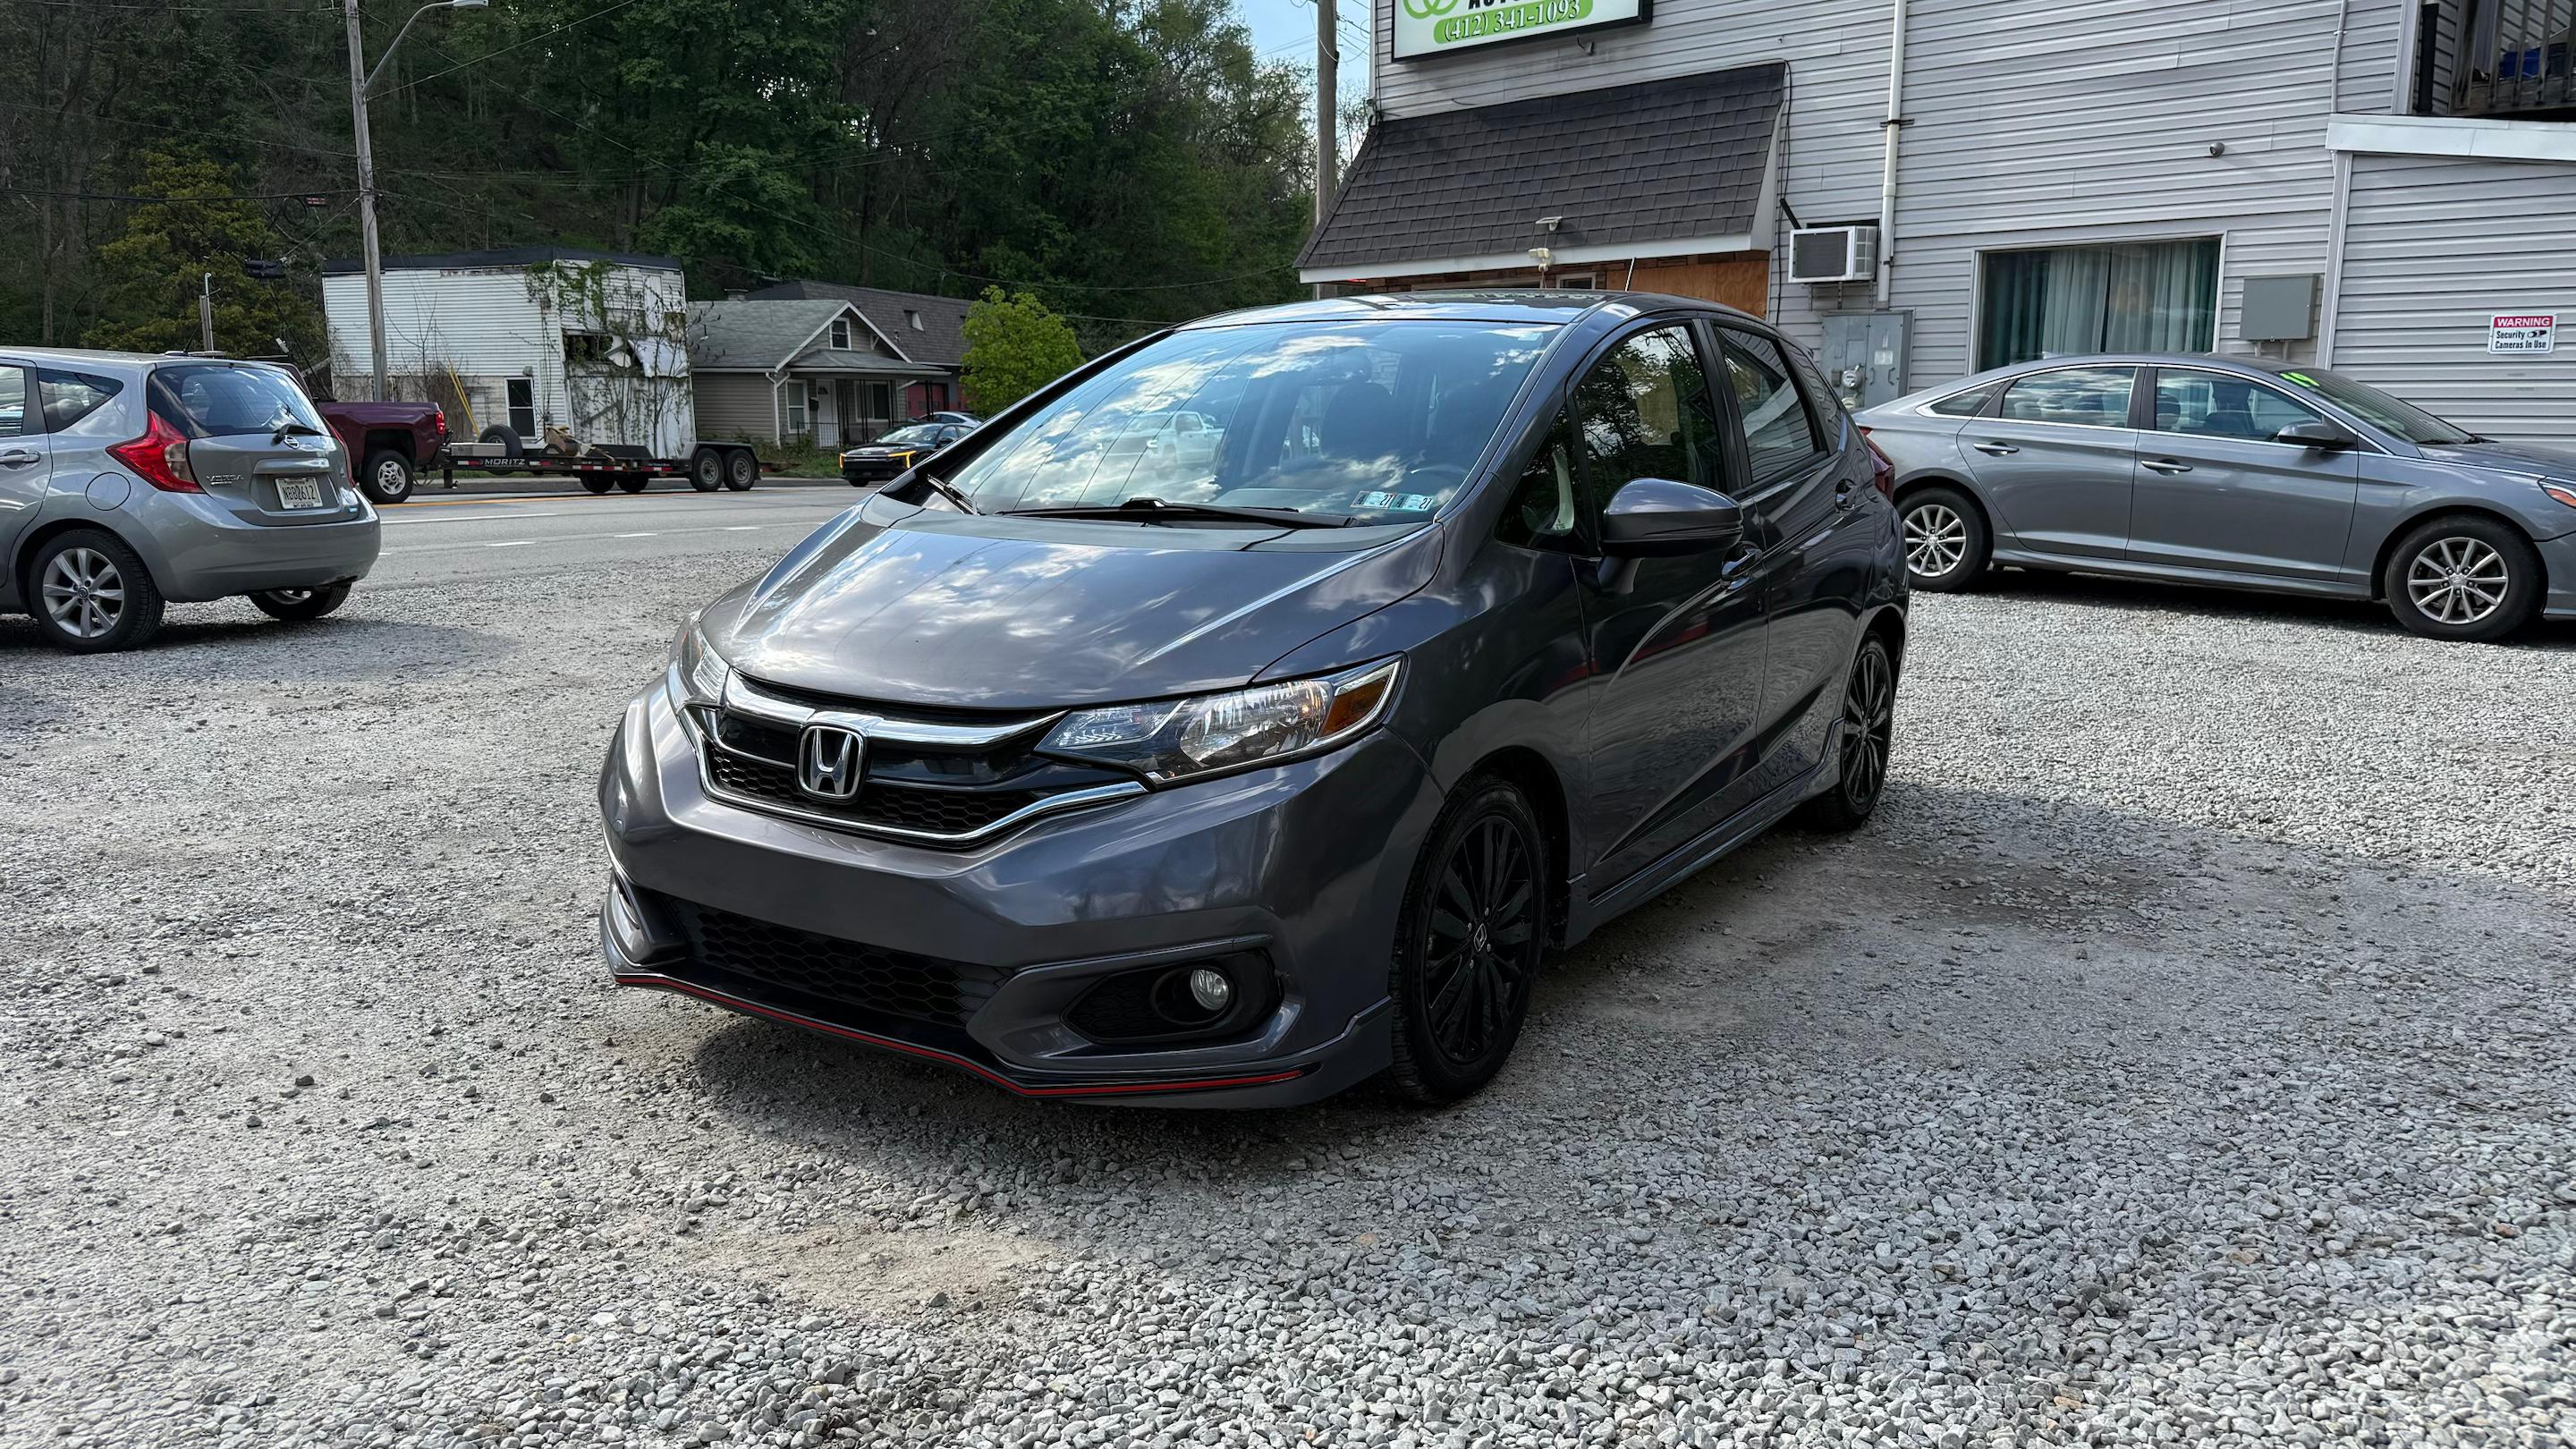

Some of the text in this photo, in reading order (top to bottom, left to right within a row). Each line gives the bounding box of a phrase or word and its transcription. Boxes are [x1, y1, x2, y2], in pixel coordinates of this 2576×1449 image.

[1445, 0, 1580, 41] (412) 341-1093
[2497, 318, 2550, 326] WARNING
[2496, 331, 2525, 339] Security
[2534, 340, 2546, 348] Use
[1379, 494, 1394, 506] 27
[1419, 497, 1432, 510] 27
